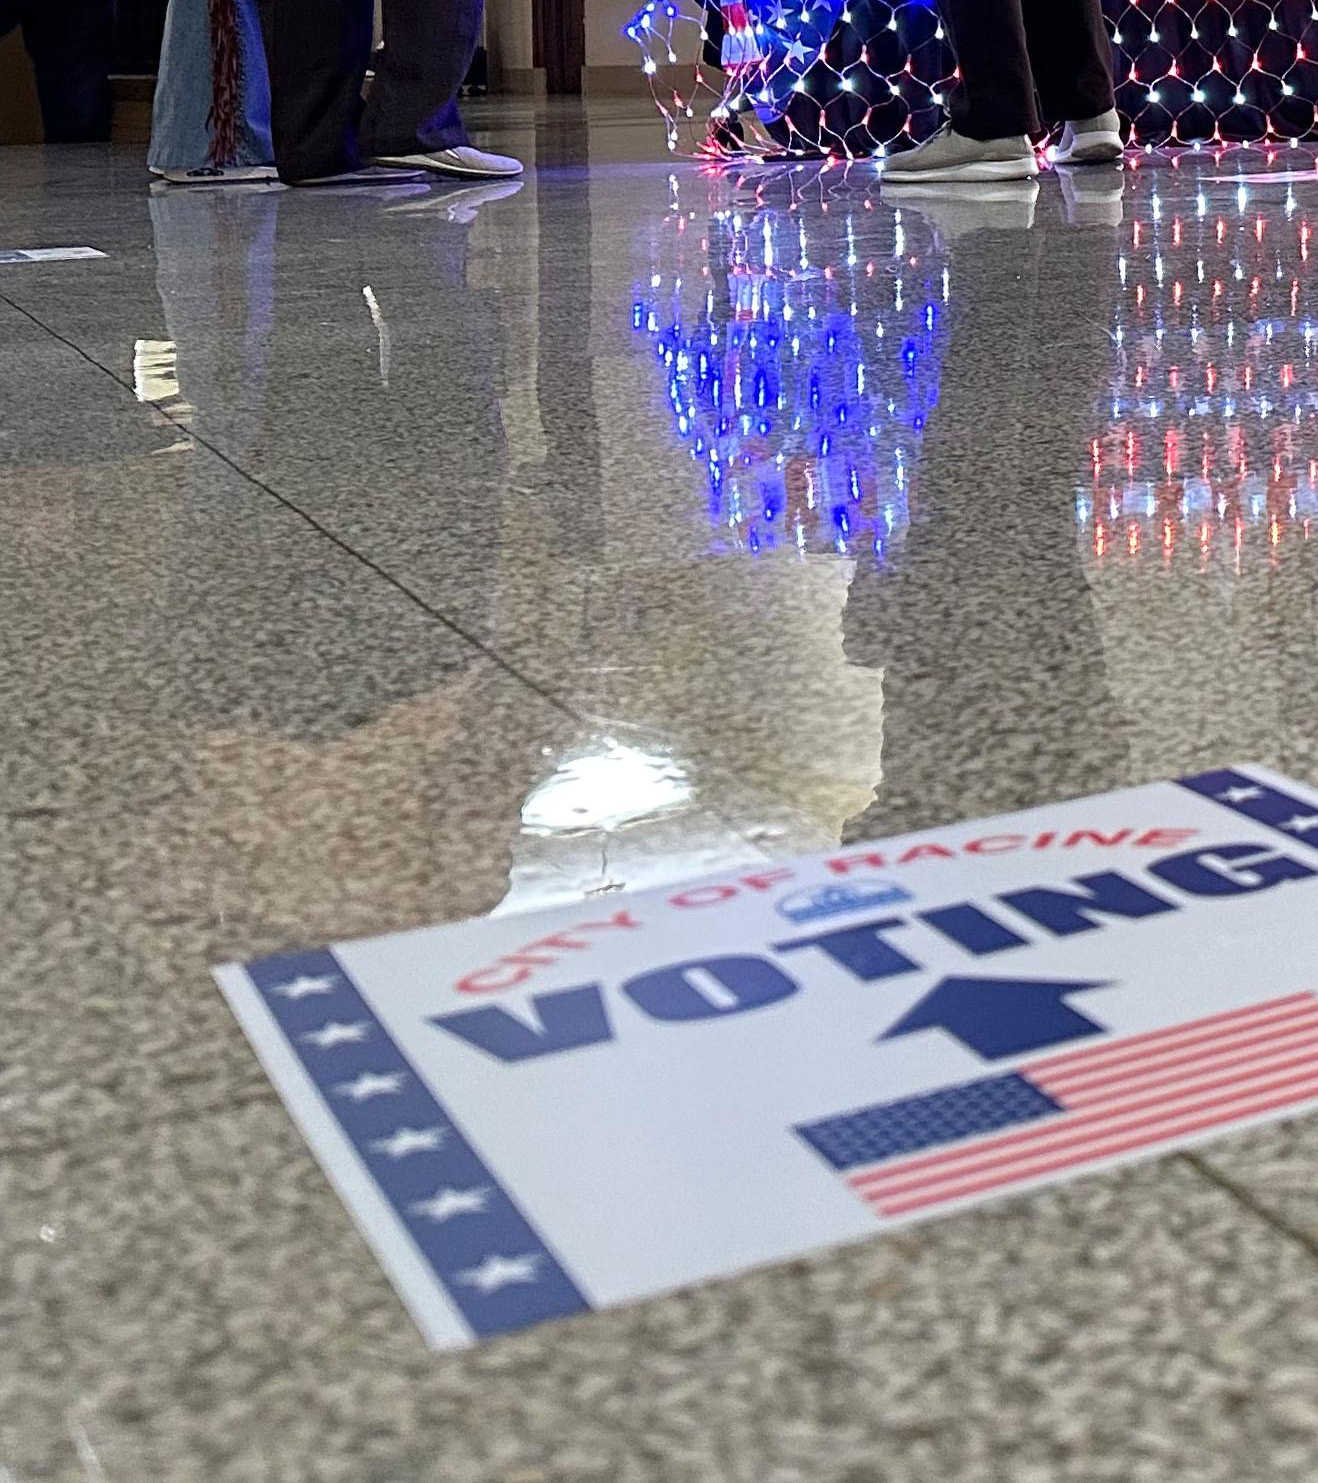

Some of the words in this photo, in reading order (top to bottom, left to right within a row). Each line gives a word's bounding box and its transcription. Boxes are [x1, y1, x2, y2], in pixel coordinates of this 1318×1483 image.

[453, 908, 644, 998] CITY
[667, 867, 797, 910] OF
[823, 827, 1203, 876] RACINE
